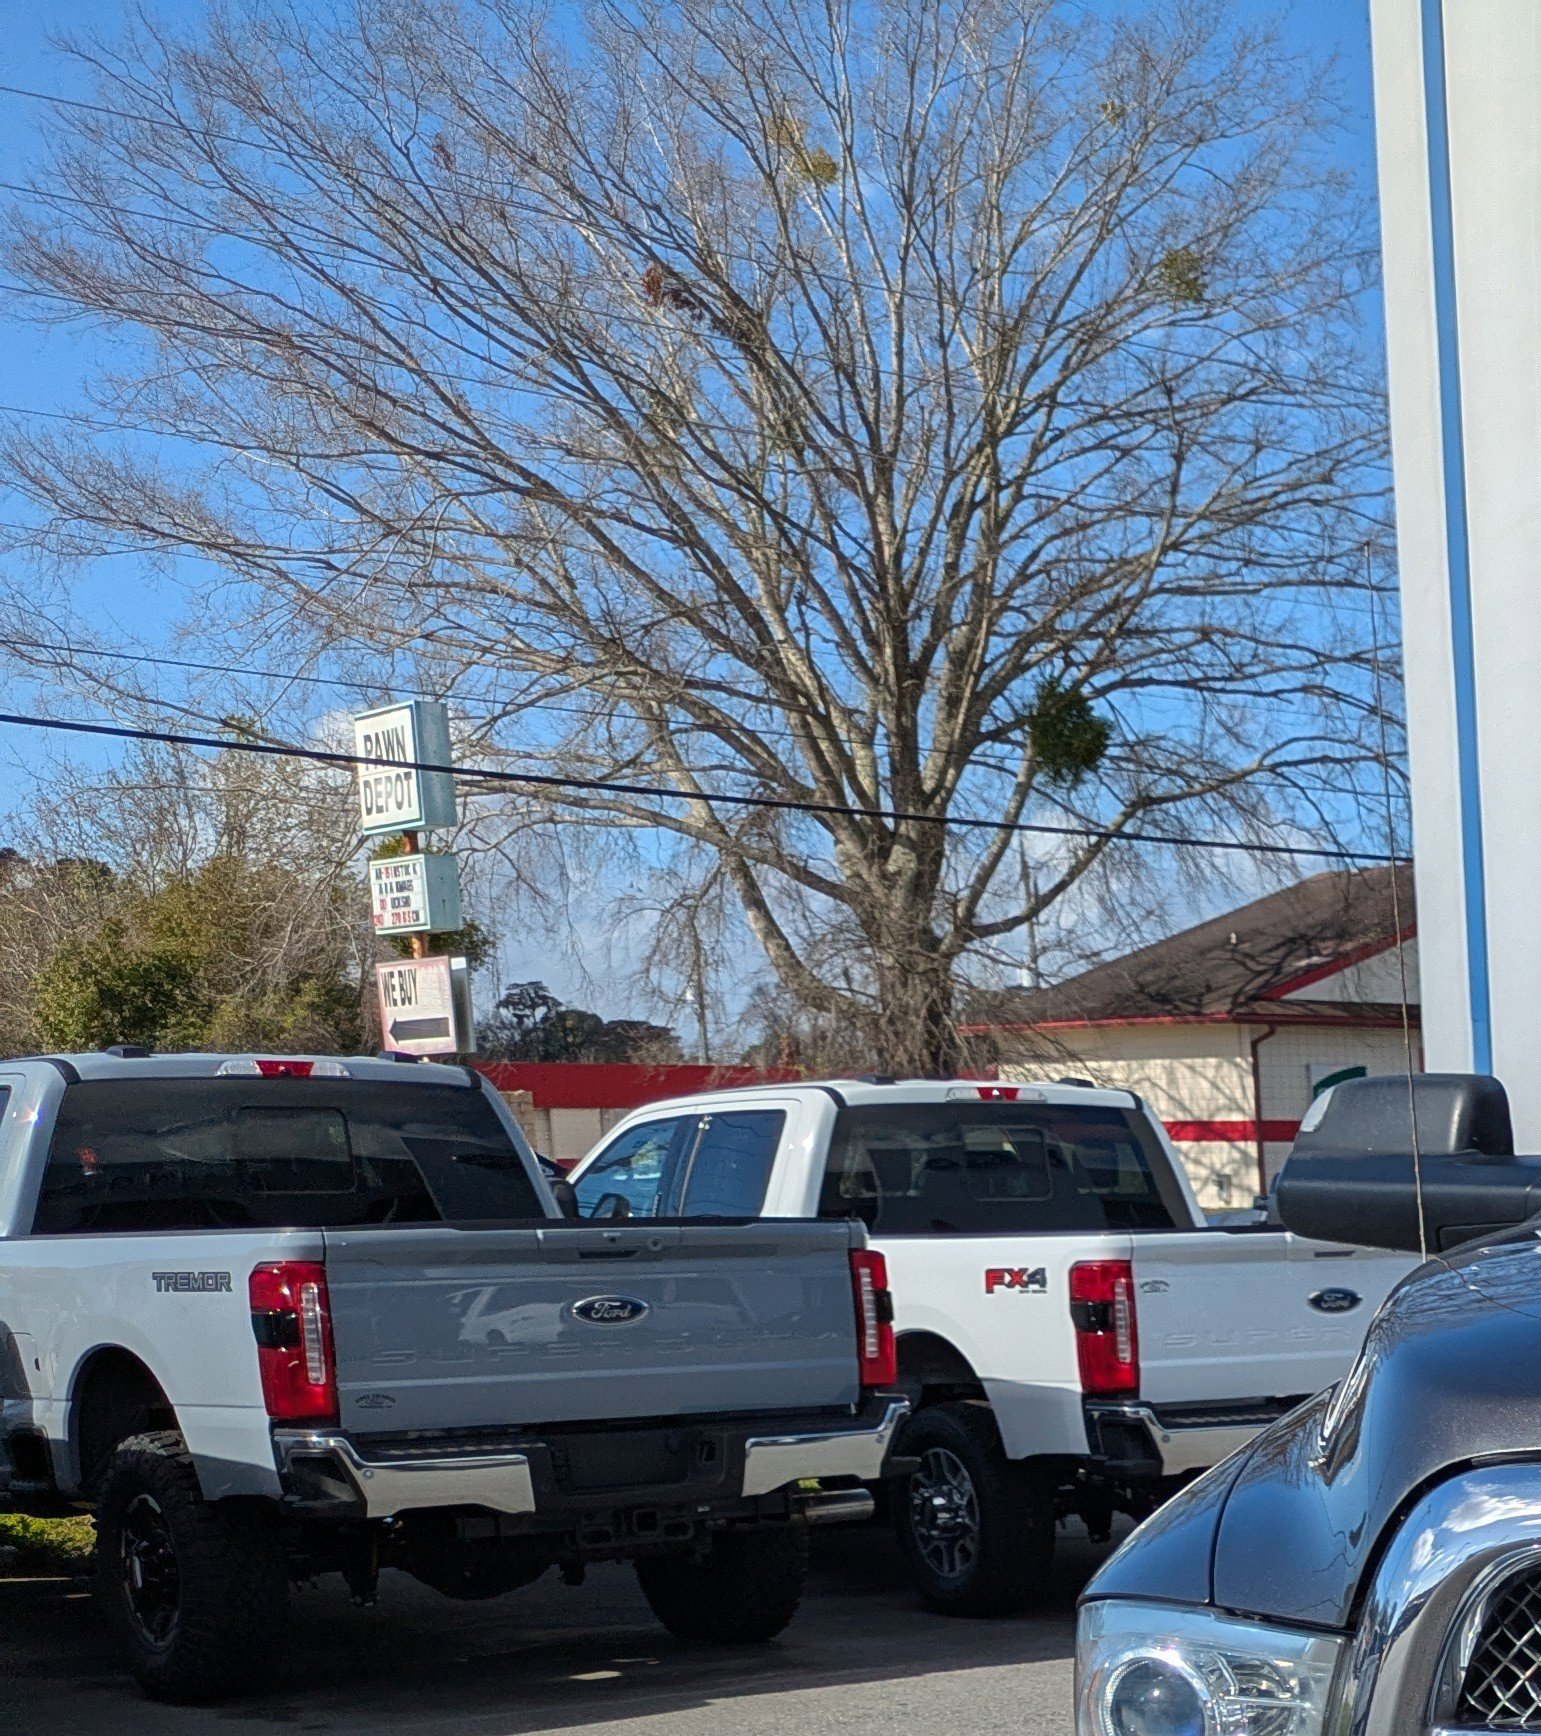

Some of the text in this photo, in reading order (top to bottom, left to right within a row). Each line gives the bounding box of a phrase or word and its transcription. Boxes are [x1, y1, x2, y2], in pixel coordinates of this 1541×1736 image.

[363, 725, 408, 771] PAWN
[363, 771, 413, 816] DEPOT
[381, 967, 419, 1008] WE BUY
[152, 1271, 233, 1293] TREMOR
[985, 1267, 1047, 1294] FX4
